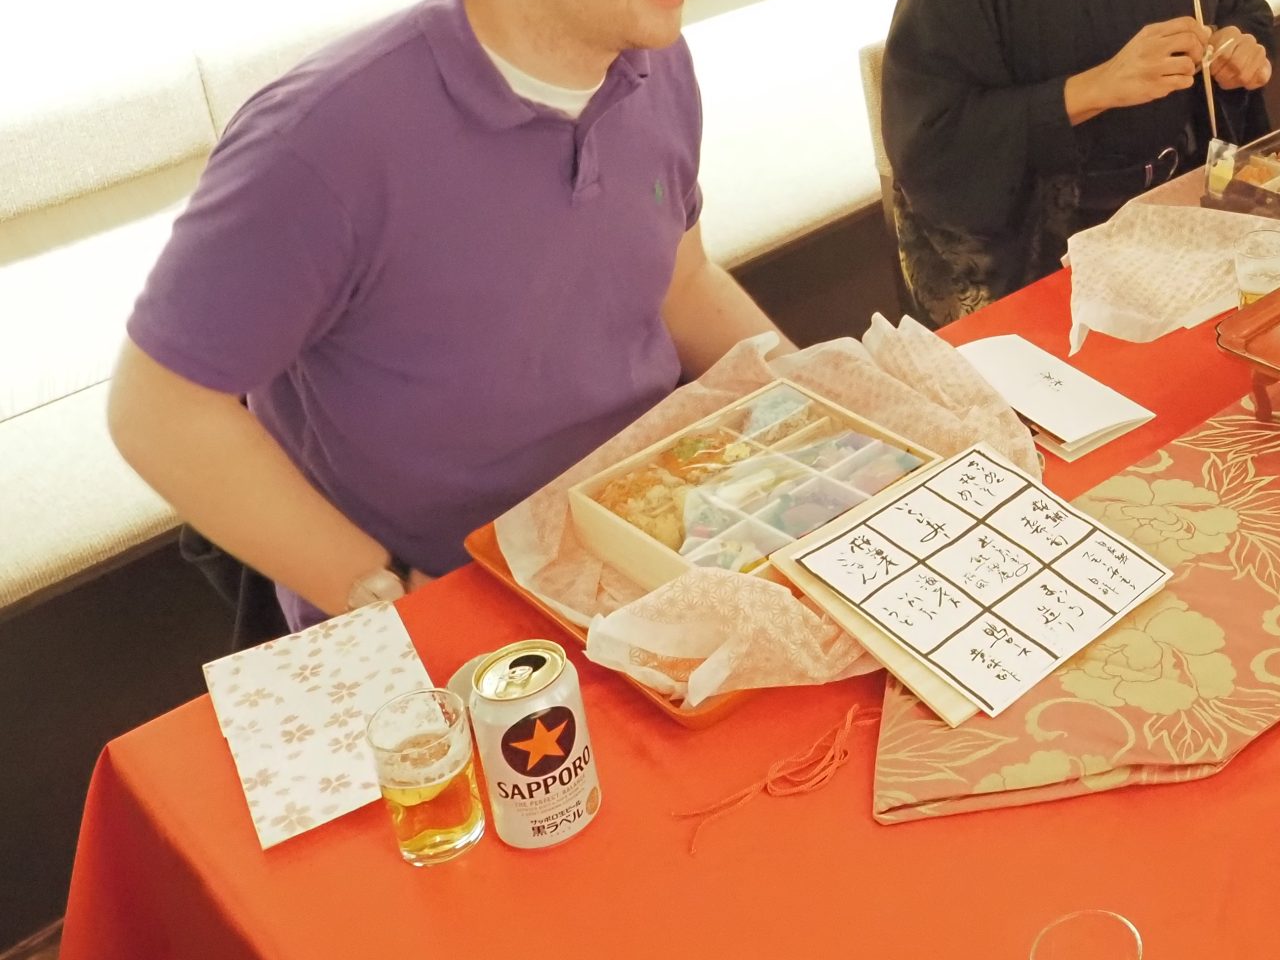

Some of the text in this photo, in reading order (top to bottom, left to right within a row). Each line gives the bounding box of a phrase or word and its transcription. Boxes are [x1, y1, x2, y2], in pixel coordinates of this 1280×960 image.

[497, 745, 590, 800] SAPPORO
[530, 800, 582, 825] サッポロ生ビール
[532, 808, 584, 837] 黒ラベル
